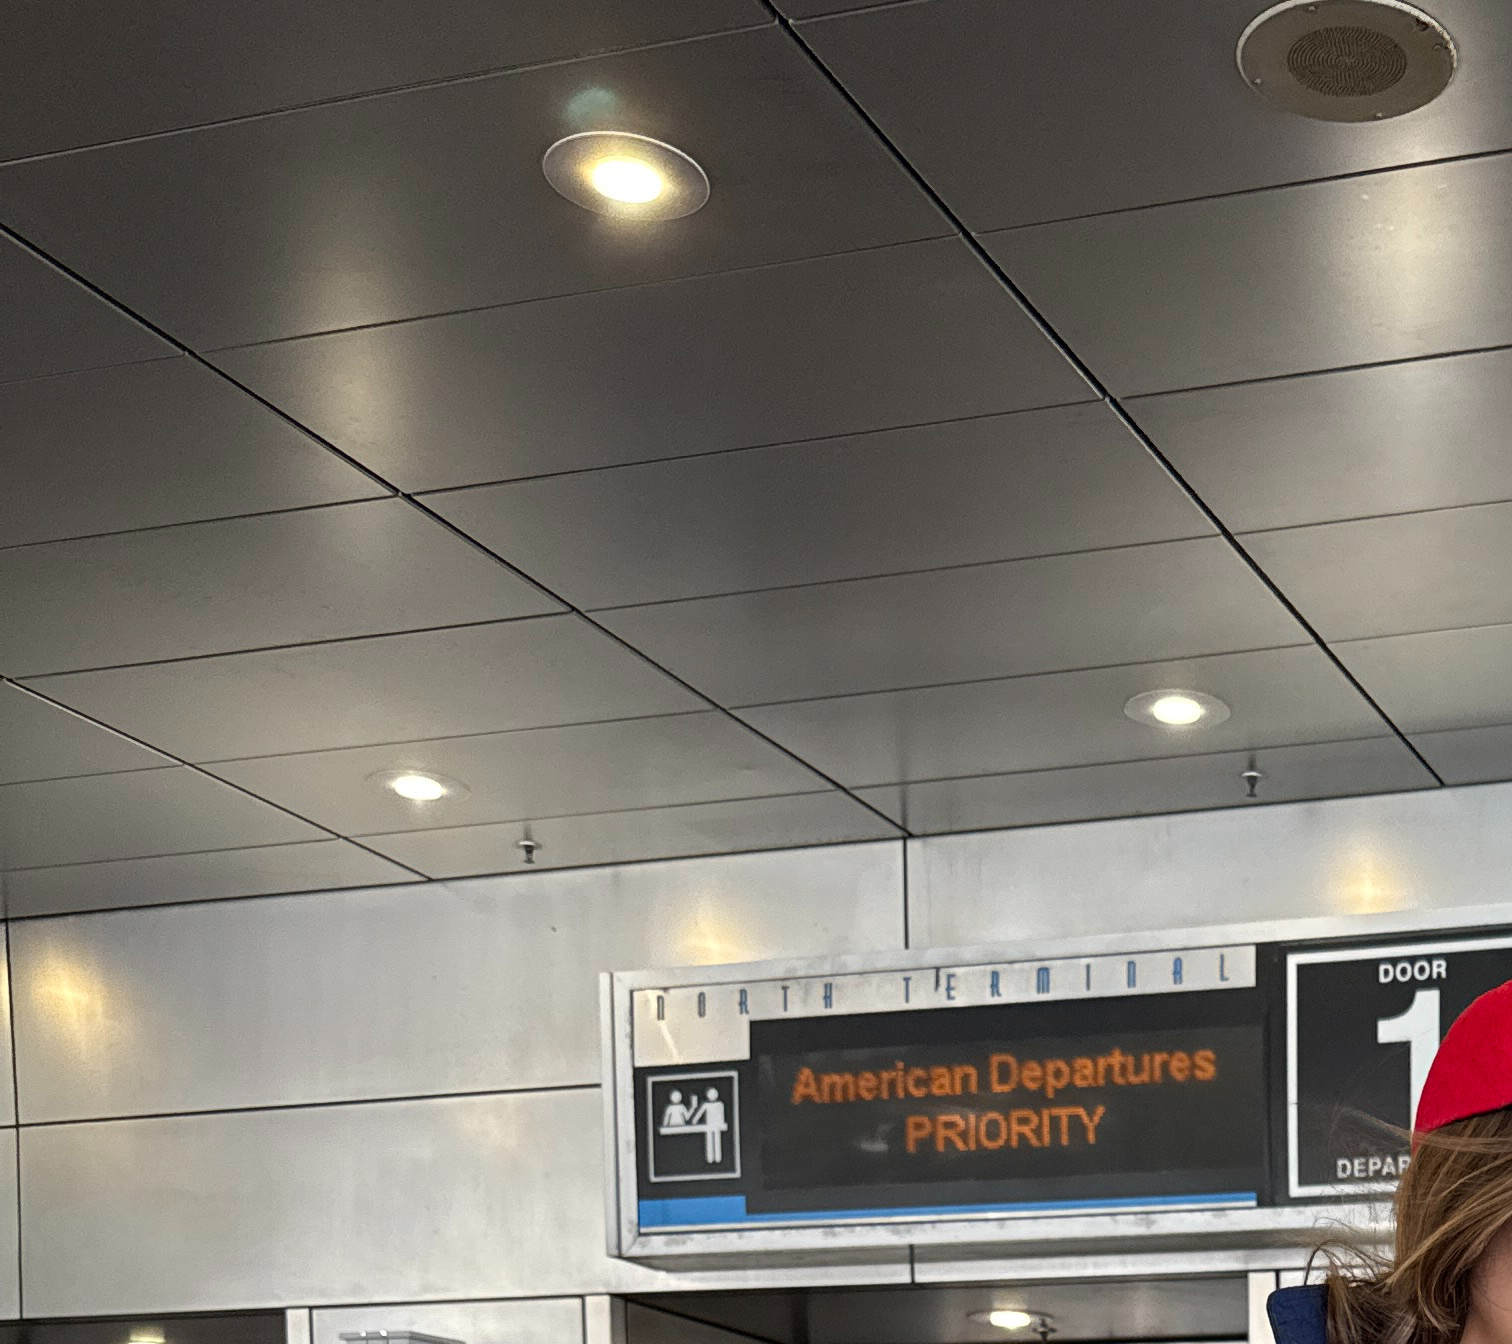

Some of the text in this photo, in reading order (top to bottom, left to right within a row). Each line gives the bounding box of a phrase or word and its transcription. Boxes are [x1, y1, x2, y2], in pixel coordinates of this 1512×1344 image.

[655, 953, 1230, 1021] NORTH TERMINAL
[1378, 959, 1447, 984] DOOR
[792, 1047, 1216, 1104] American Departures
[906, 1106, 1106, 1153] PRIORITY
